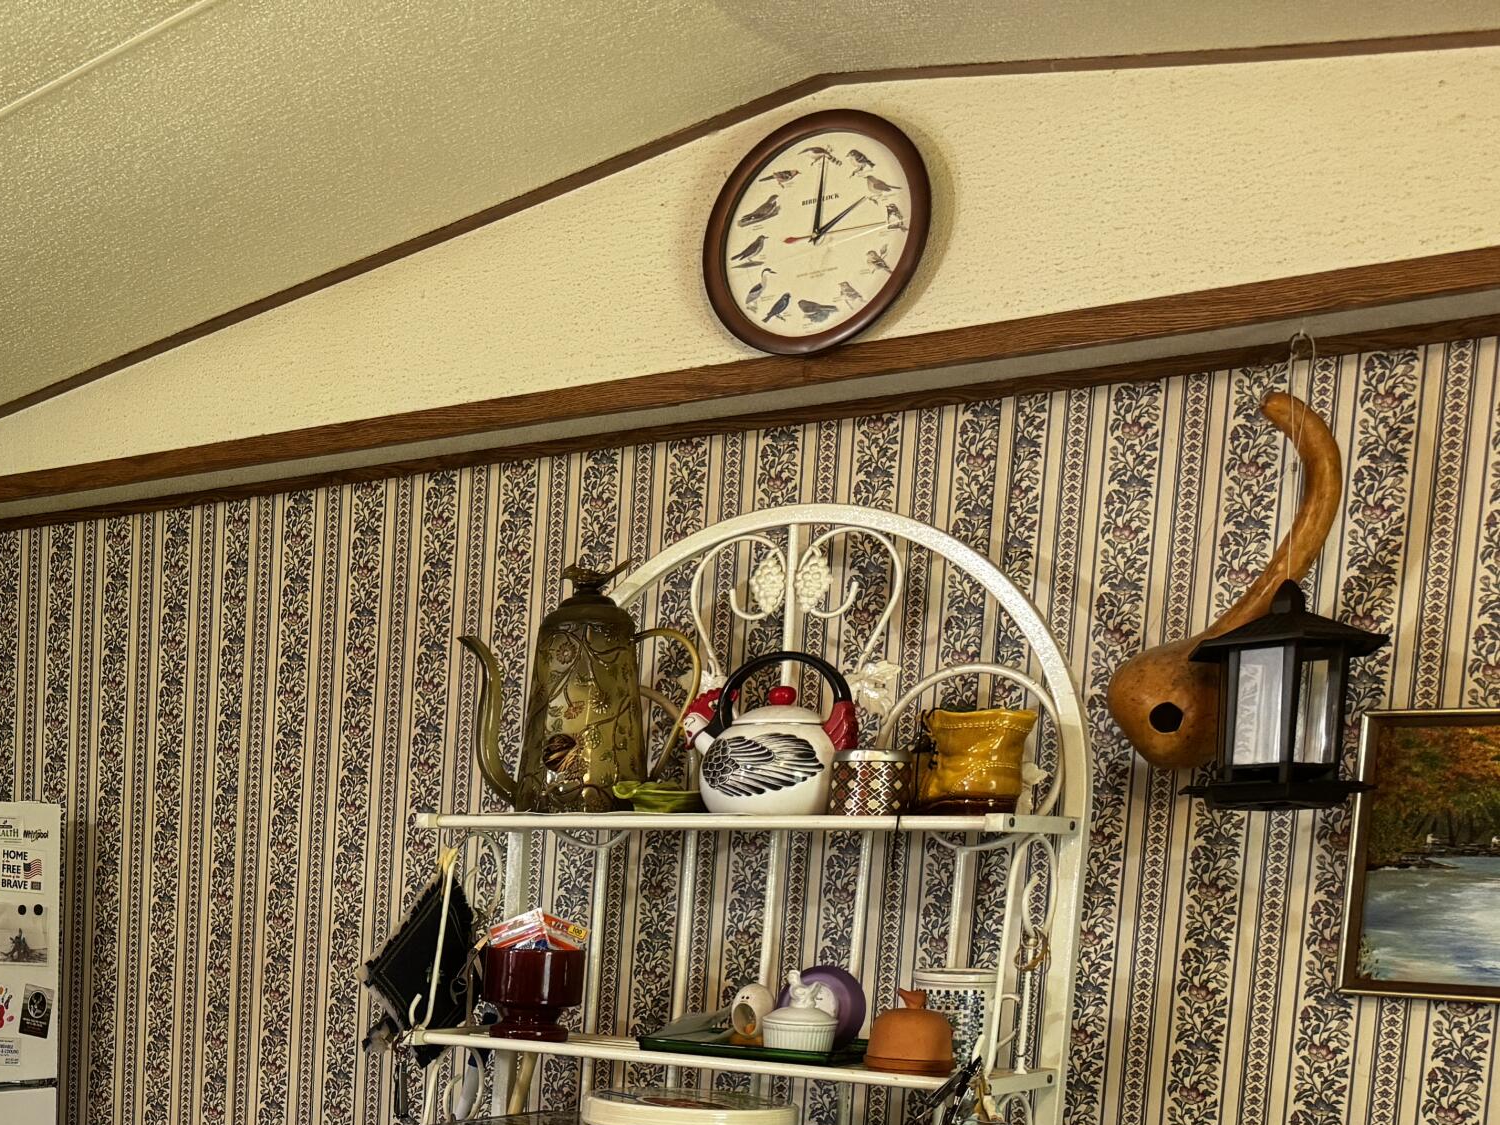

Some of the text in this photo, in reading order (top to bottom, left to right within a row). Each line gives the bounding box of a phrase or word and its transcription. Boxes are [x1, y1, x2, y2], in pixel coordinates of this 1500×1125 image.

[23, 829, 49, 842] Whirlpool
[2, 849, 28, 860] HOME
[2, 864, 21, 874] FREE
[1, 879, 28, 889] BRAVE
